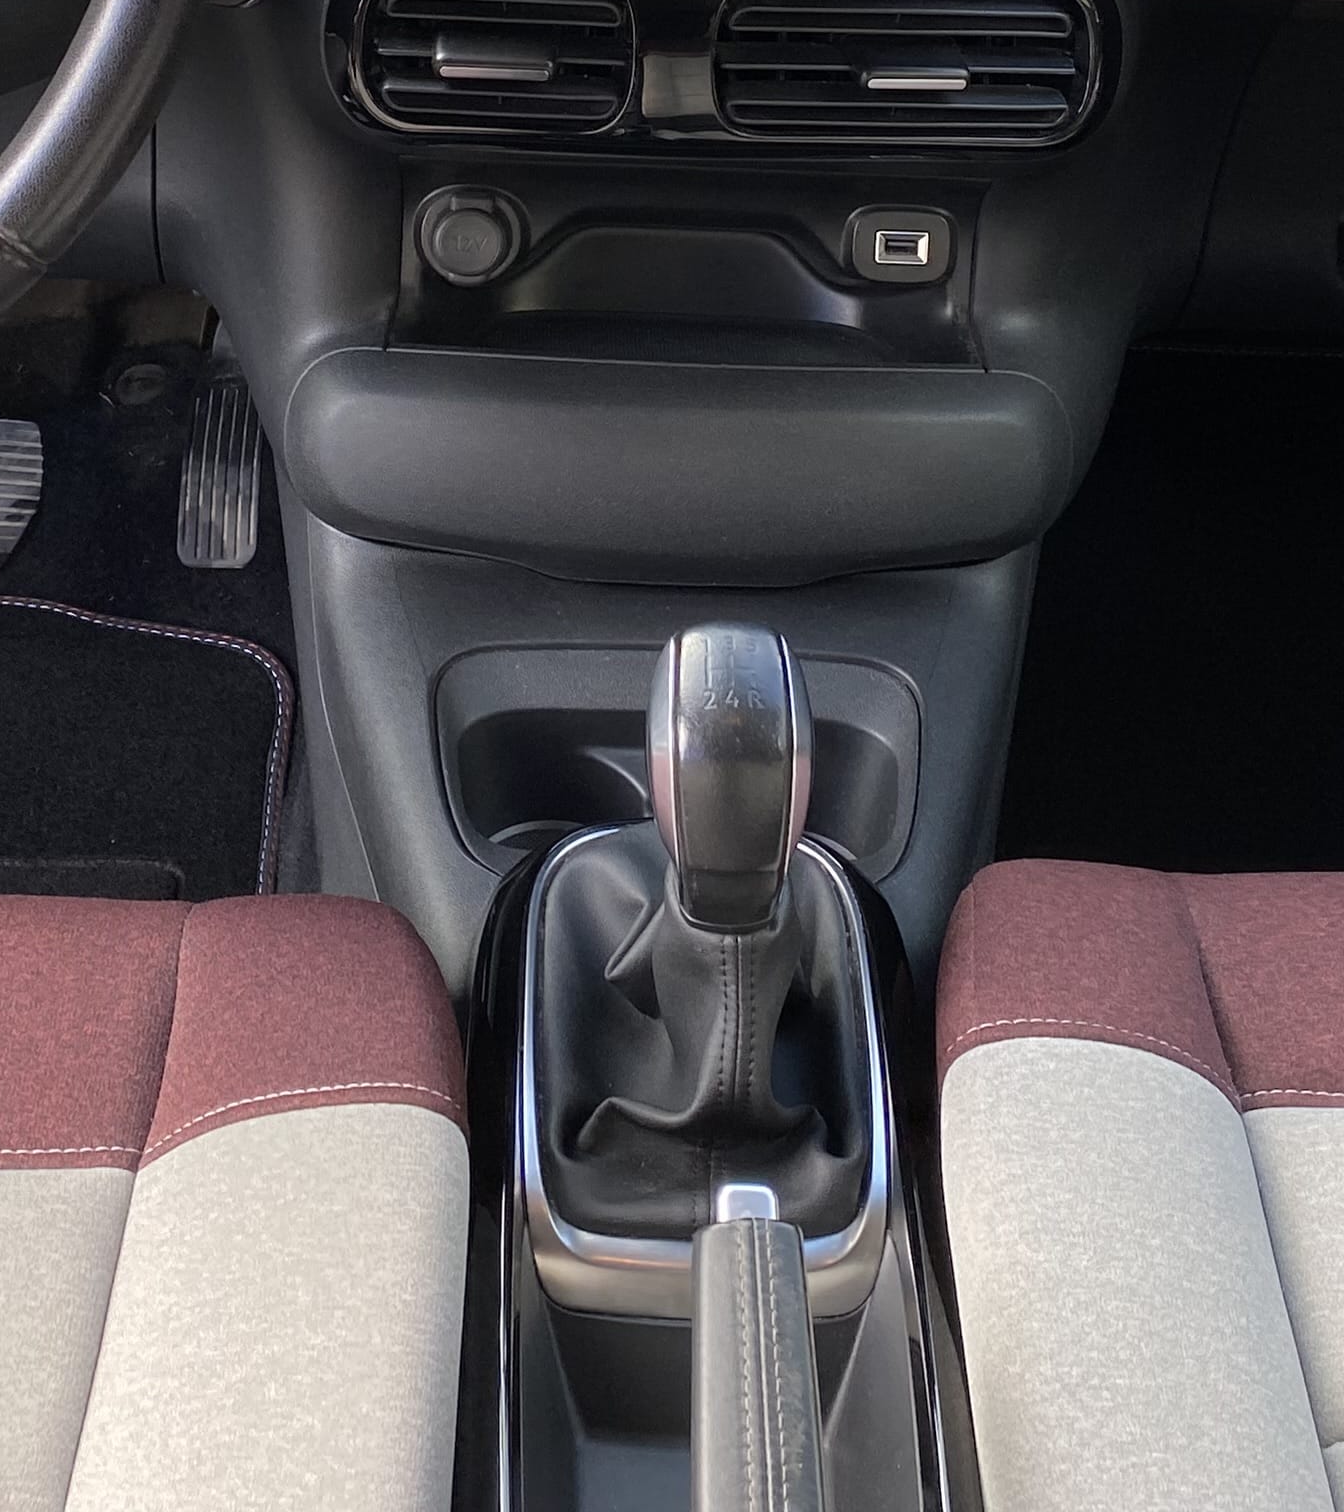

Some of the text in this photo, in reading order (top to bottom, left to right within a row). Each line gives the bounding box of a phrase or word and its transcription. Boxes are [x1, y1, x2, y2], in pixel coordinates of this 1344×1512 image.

[703, 689, 765, 711] 2 4 R
